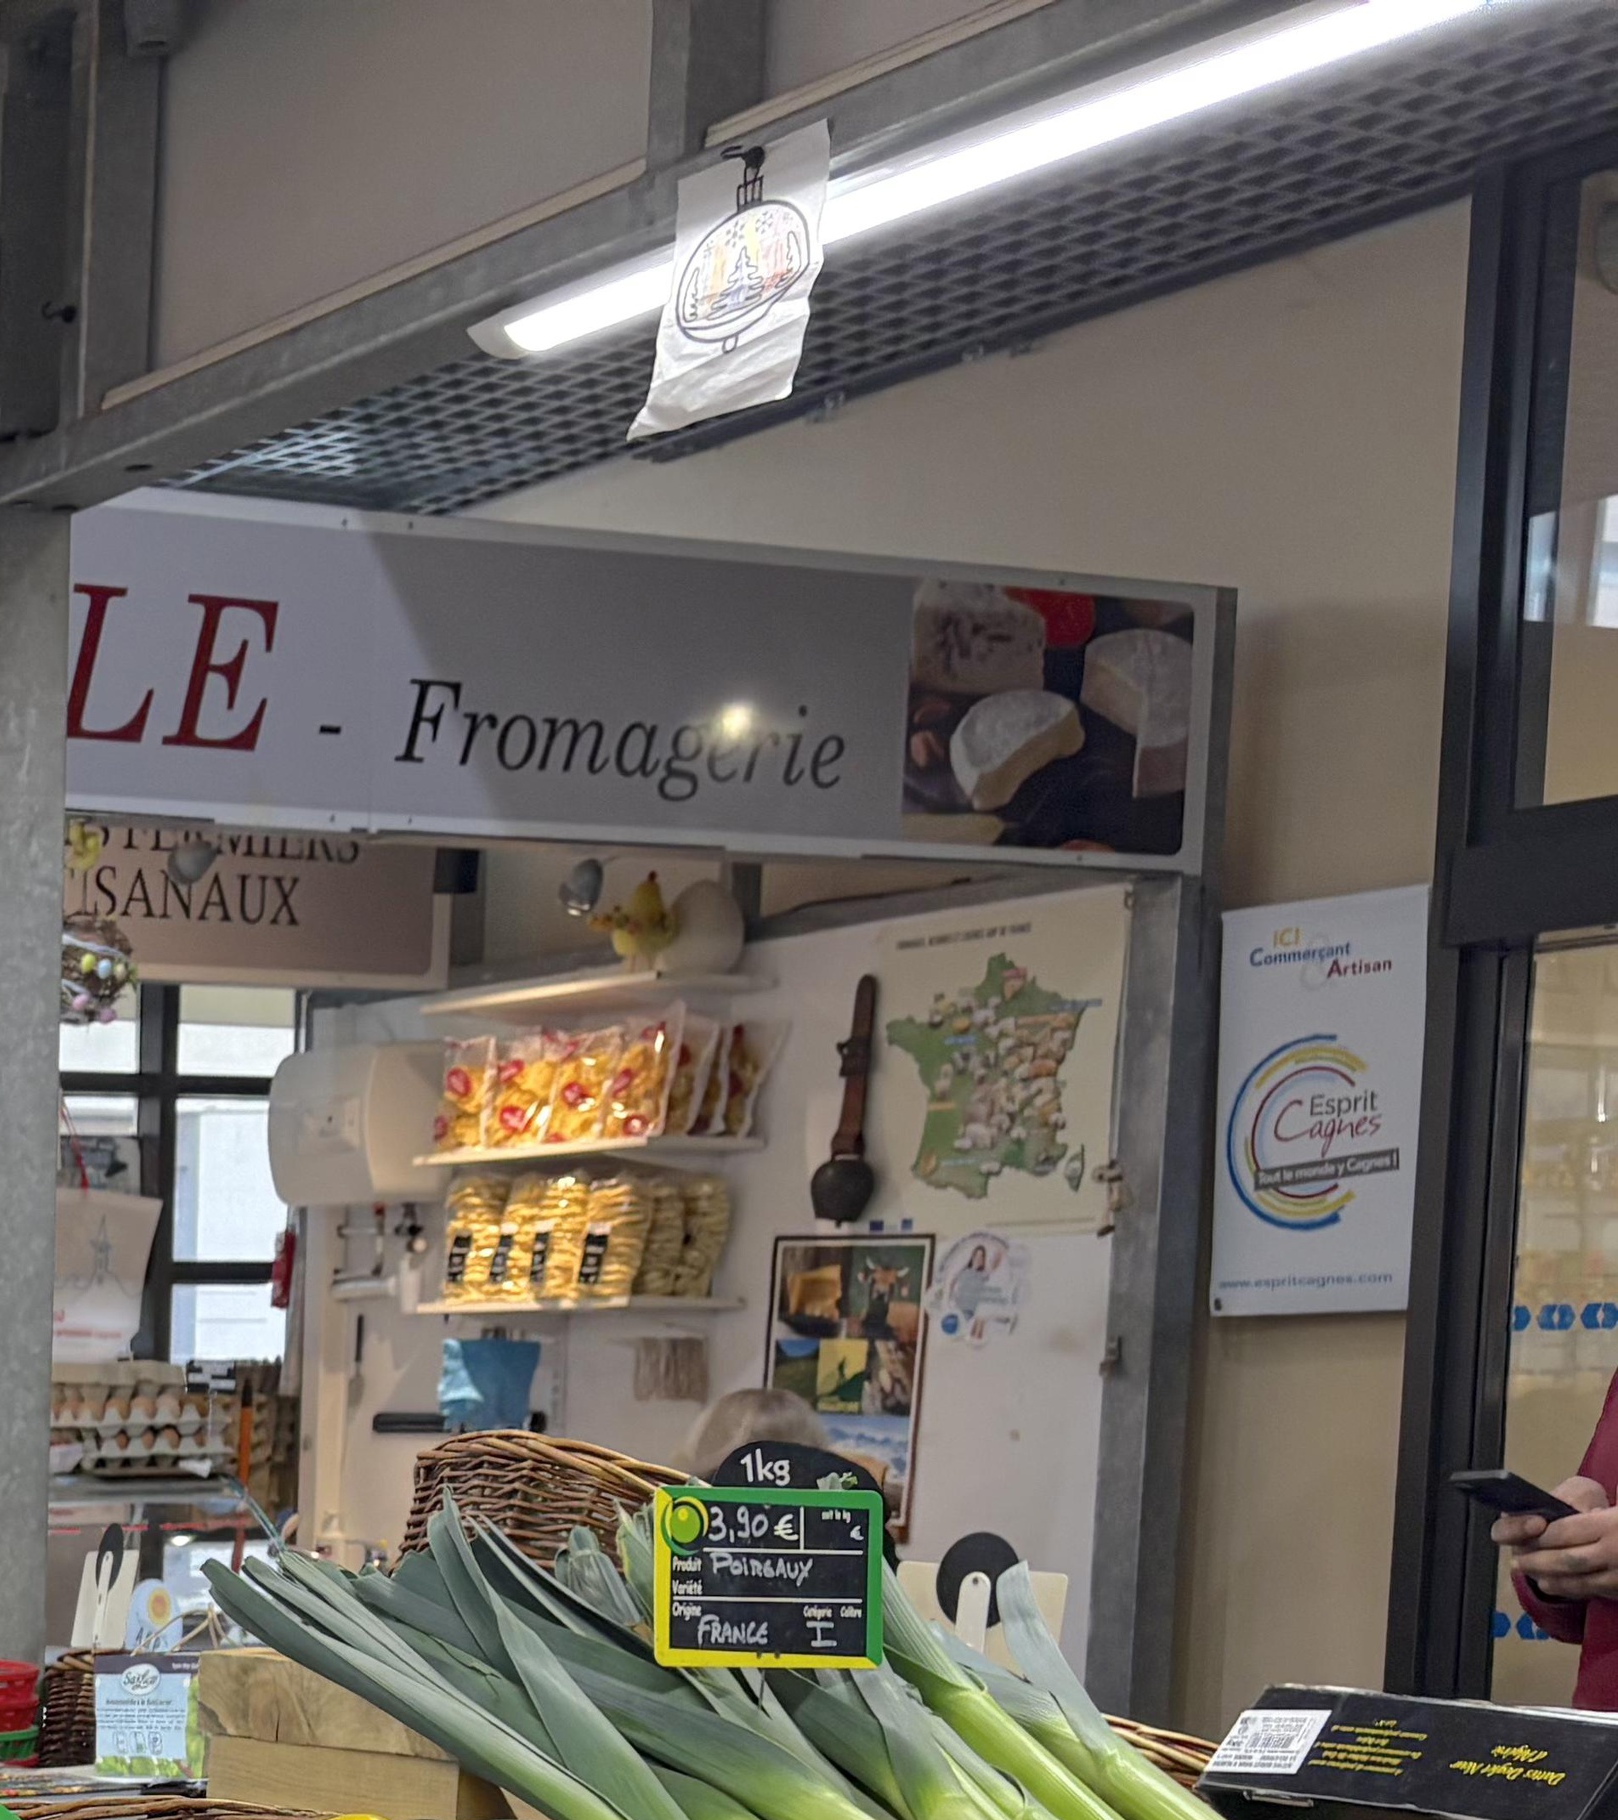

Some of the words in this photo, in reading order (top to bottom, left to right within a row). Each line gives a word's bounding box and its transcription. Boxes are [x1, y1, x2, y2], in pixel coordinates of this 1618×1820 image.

[394, 678, 846, 801] Fromagerie
[1249, 941, 1352, 968] Commerçant
[1326, 958, 1393, 980] Artisan
[1309, 1090, 1379, 1117] Esprit
[1273, 1099, 1383, 1158] Cagnes
[740, 1448, 790, 1486] 1kg
[709, 1506, 768, 1543] 3,90
[773, 1514, 799, 1541] €
[698, 1614, 768, 1645] FRANCE
